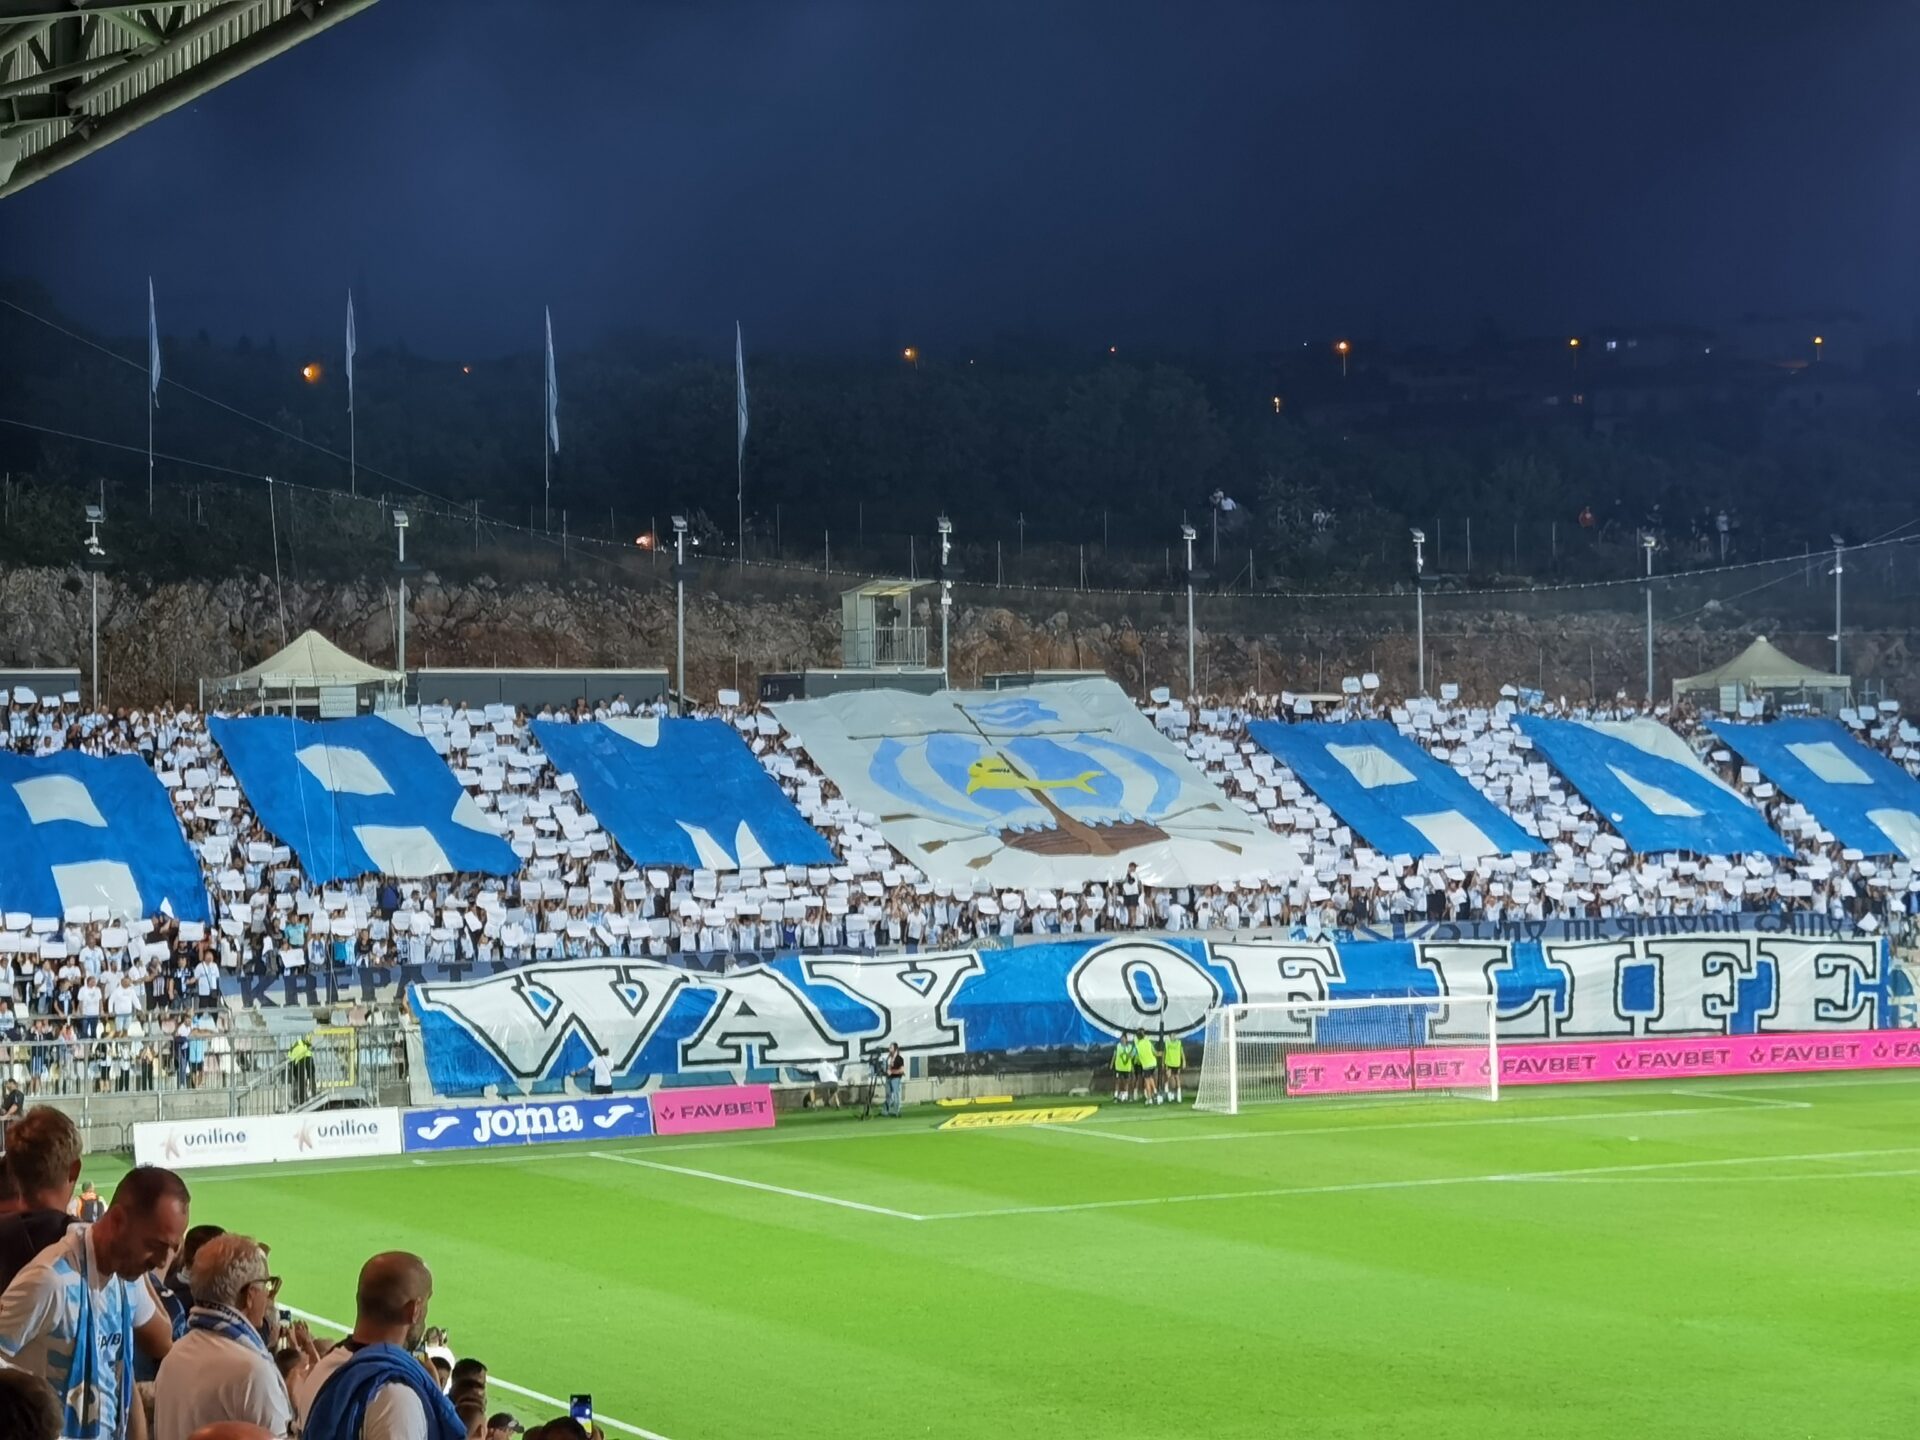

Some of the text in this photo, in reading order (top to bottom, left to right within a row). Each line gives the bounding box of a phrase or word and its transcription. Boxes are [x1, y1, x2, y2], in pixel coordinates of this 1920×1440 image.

[415, 936, 1882, 1082] WAY OF LIFE
[1367, 1060, 1465, 1081] FAVBET
[1502, 1055, 1596, 1074] FAVBET
[1638, 1049, 1731, 1068] FAVBET
[1770, 1043, 1861, 1062] FAVBET
[680, 1099, 768, 1120] FAVBET
[184, 1128, 247, 1146] uniline
[317, 1119, 379, 1138] uniline
